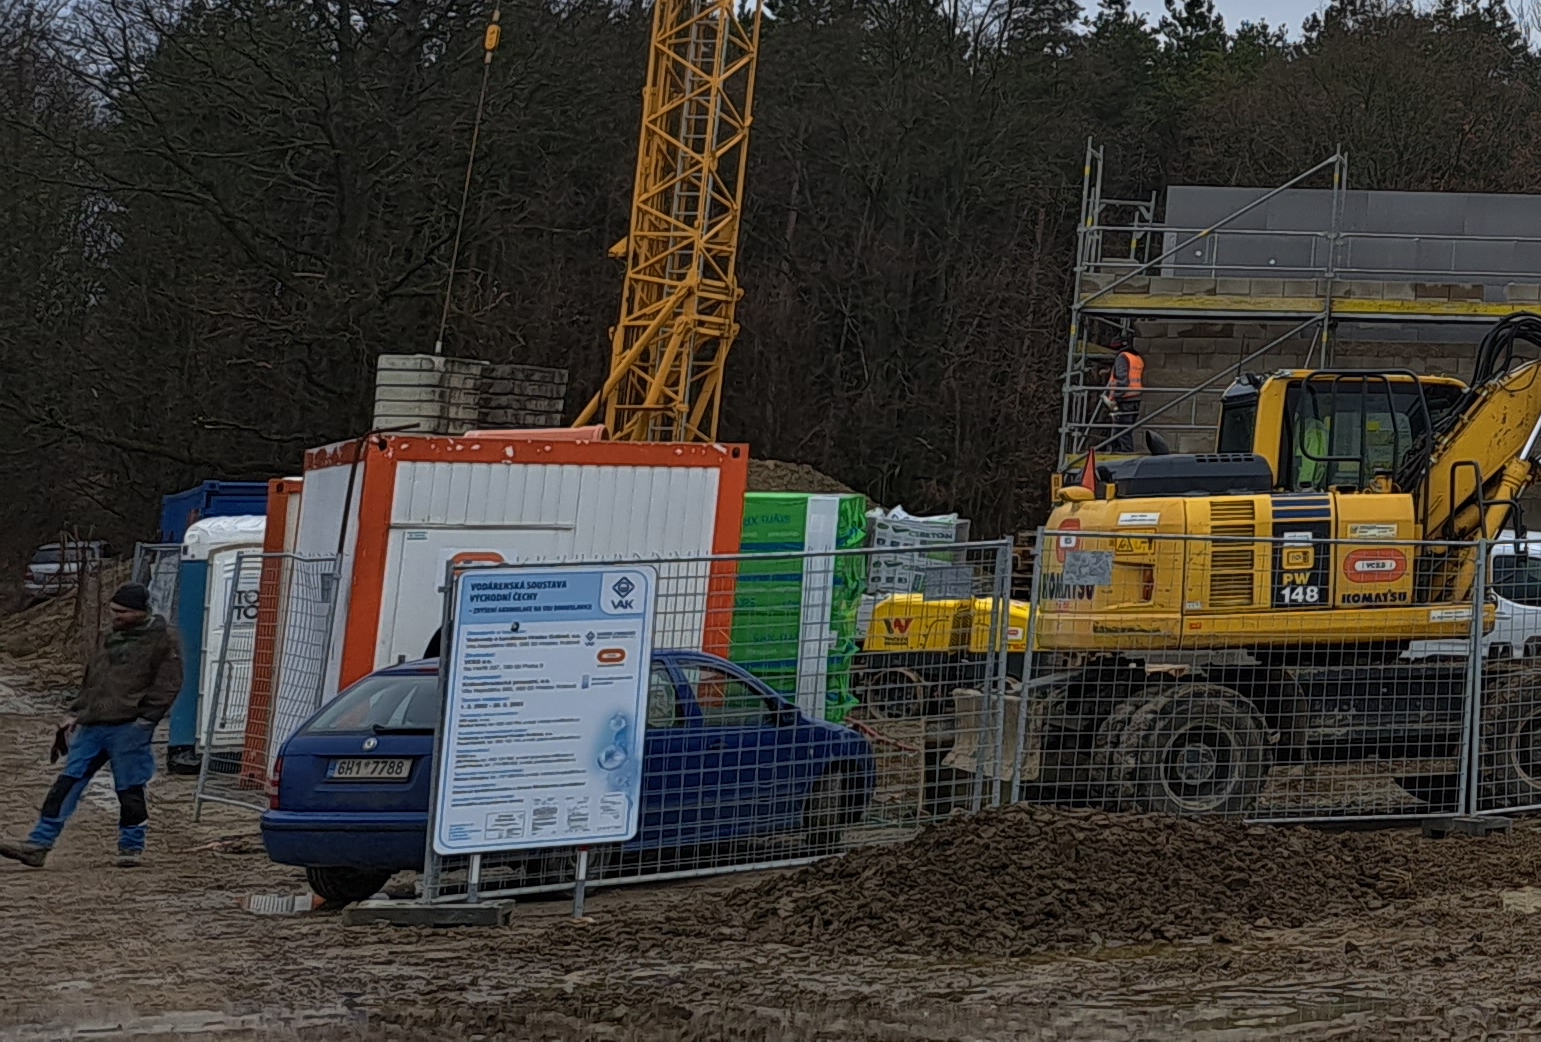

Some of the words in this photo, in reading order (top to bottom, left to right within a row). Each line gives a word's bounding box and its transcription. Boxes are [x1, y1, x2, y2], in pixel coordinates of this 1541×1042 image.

[527, 580, 567, 590] SOUSTAVA
[1283, 573, 1311, 586] PW
[470, 592, 512, 603] VÝCHODNÍ
[513, 591, 538, 601] ČECHY
[1280, 586, 1319, 603] 148
[1341, 589, 1408, 604] KOMATSU
[611, 599, 634, 610] VAK
[338, 760, 361, 776] 6H1
[370, 760, 405, 776] 7788
